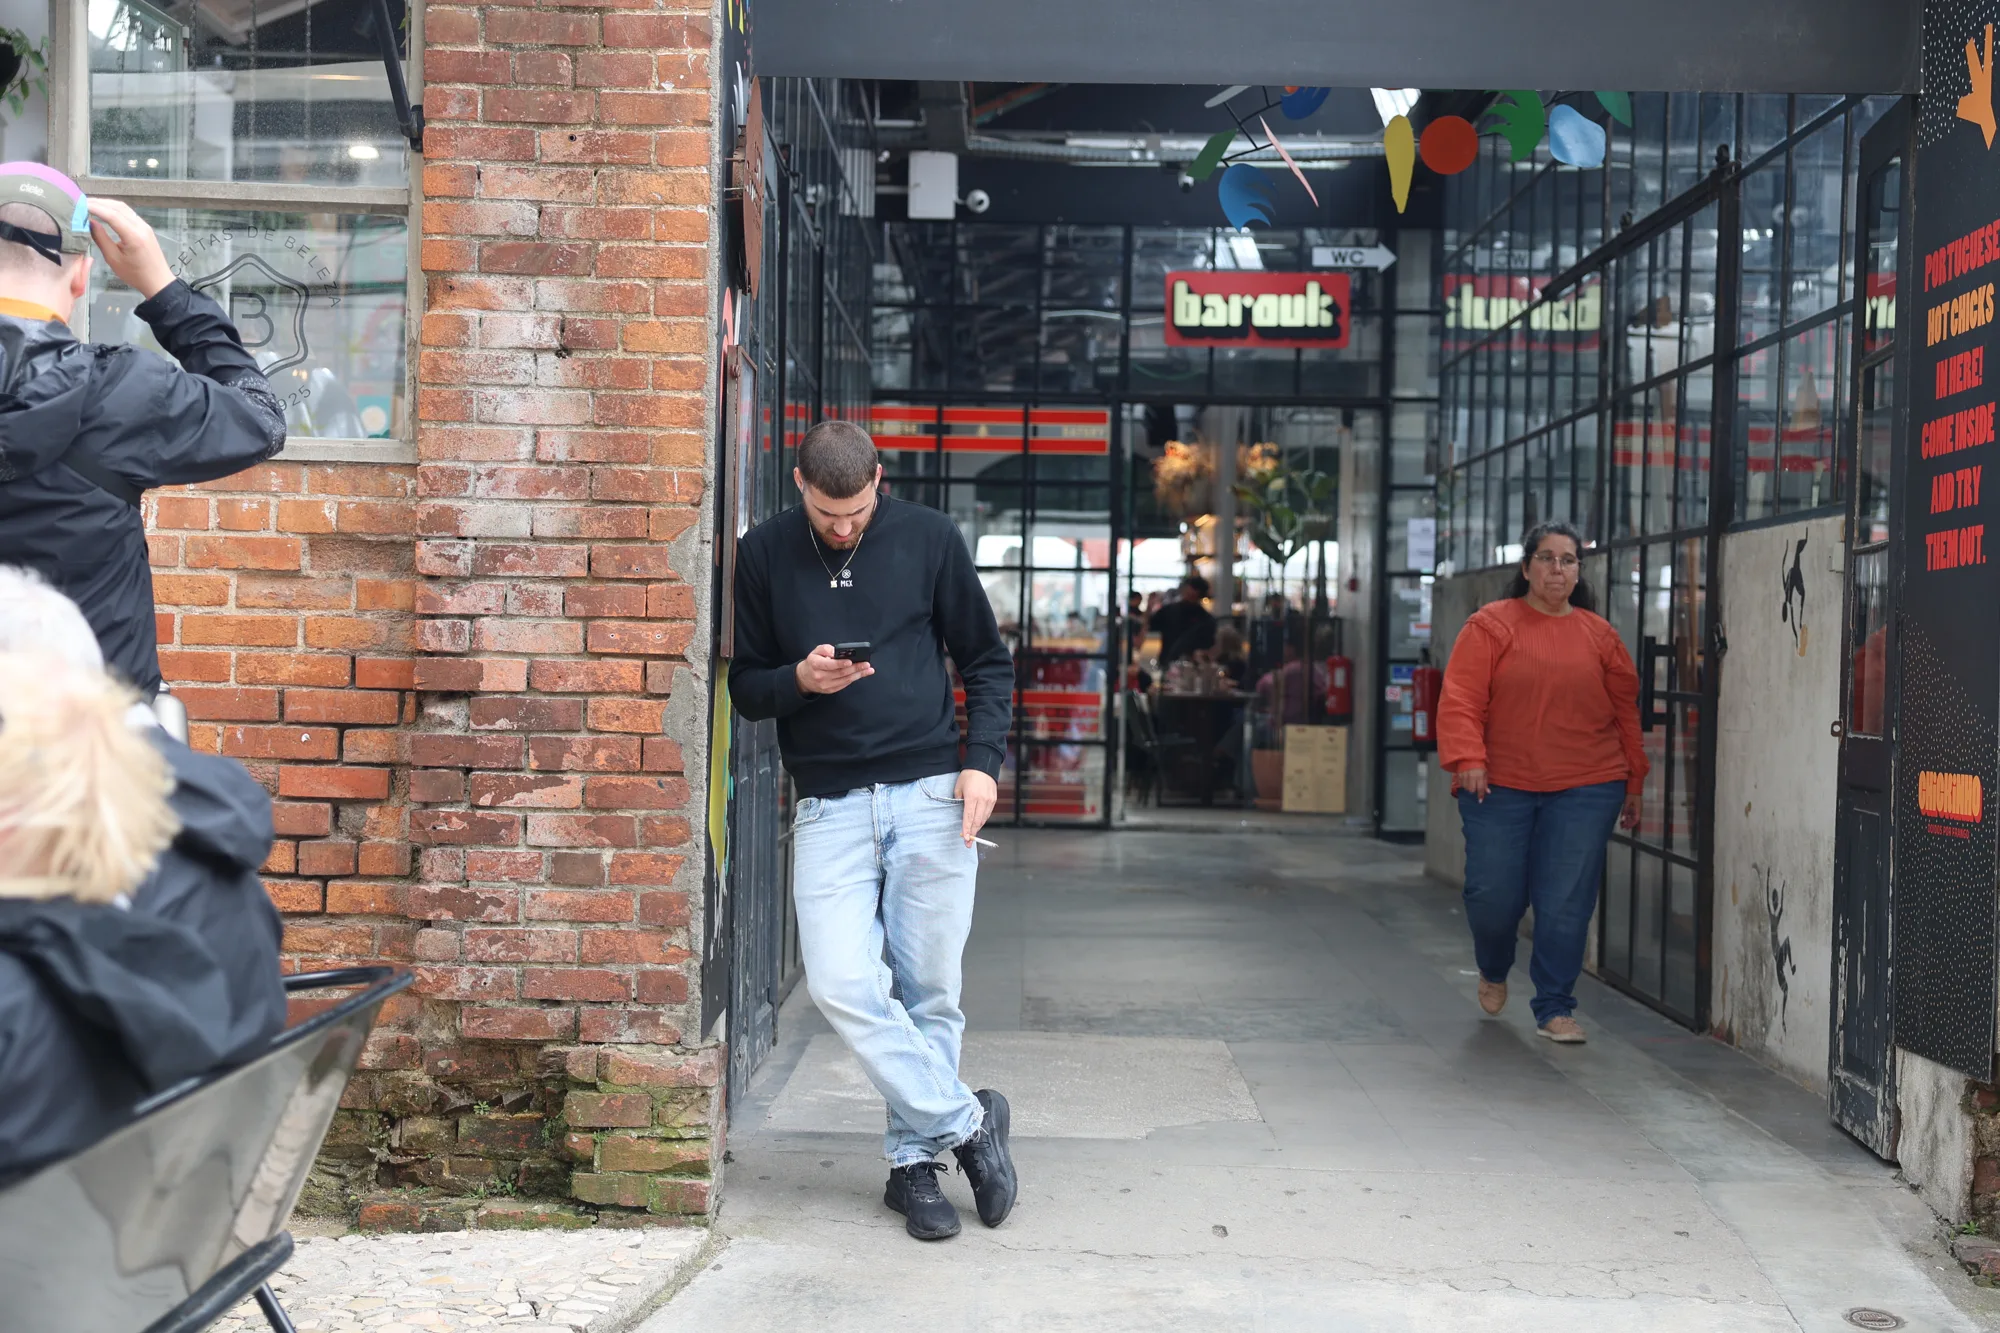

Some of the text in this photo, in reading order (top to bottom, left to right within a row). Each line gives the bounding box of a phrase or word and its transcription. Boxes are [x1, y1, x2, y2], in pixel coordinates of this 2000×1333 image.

[169, 225, 342, 308] CEITAS DE BELEZA
[1331, 250, 1365, 265] WC
[1924, 218, 2000, 292] PORTUGUESE
[1173, 279, 1335, 328] barouk
[1927, 301, 1950, 347] HOT
[1950, 282, 1995, 337] CHICKS
[1935, 345, 1984, 400] IN HERE!
[278, 386, 312, 412] 925
[1921, 401, 1996, 460] COME INSIDE
[1930, 465, 1982, 515] AND TRY
[1925, 524, 1987, 572] THEM OUT.
